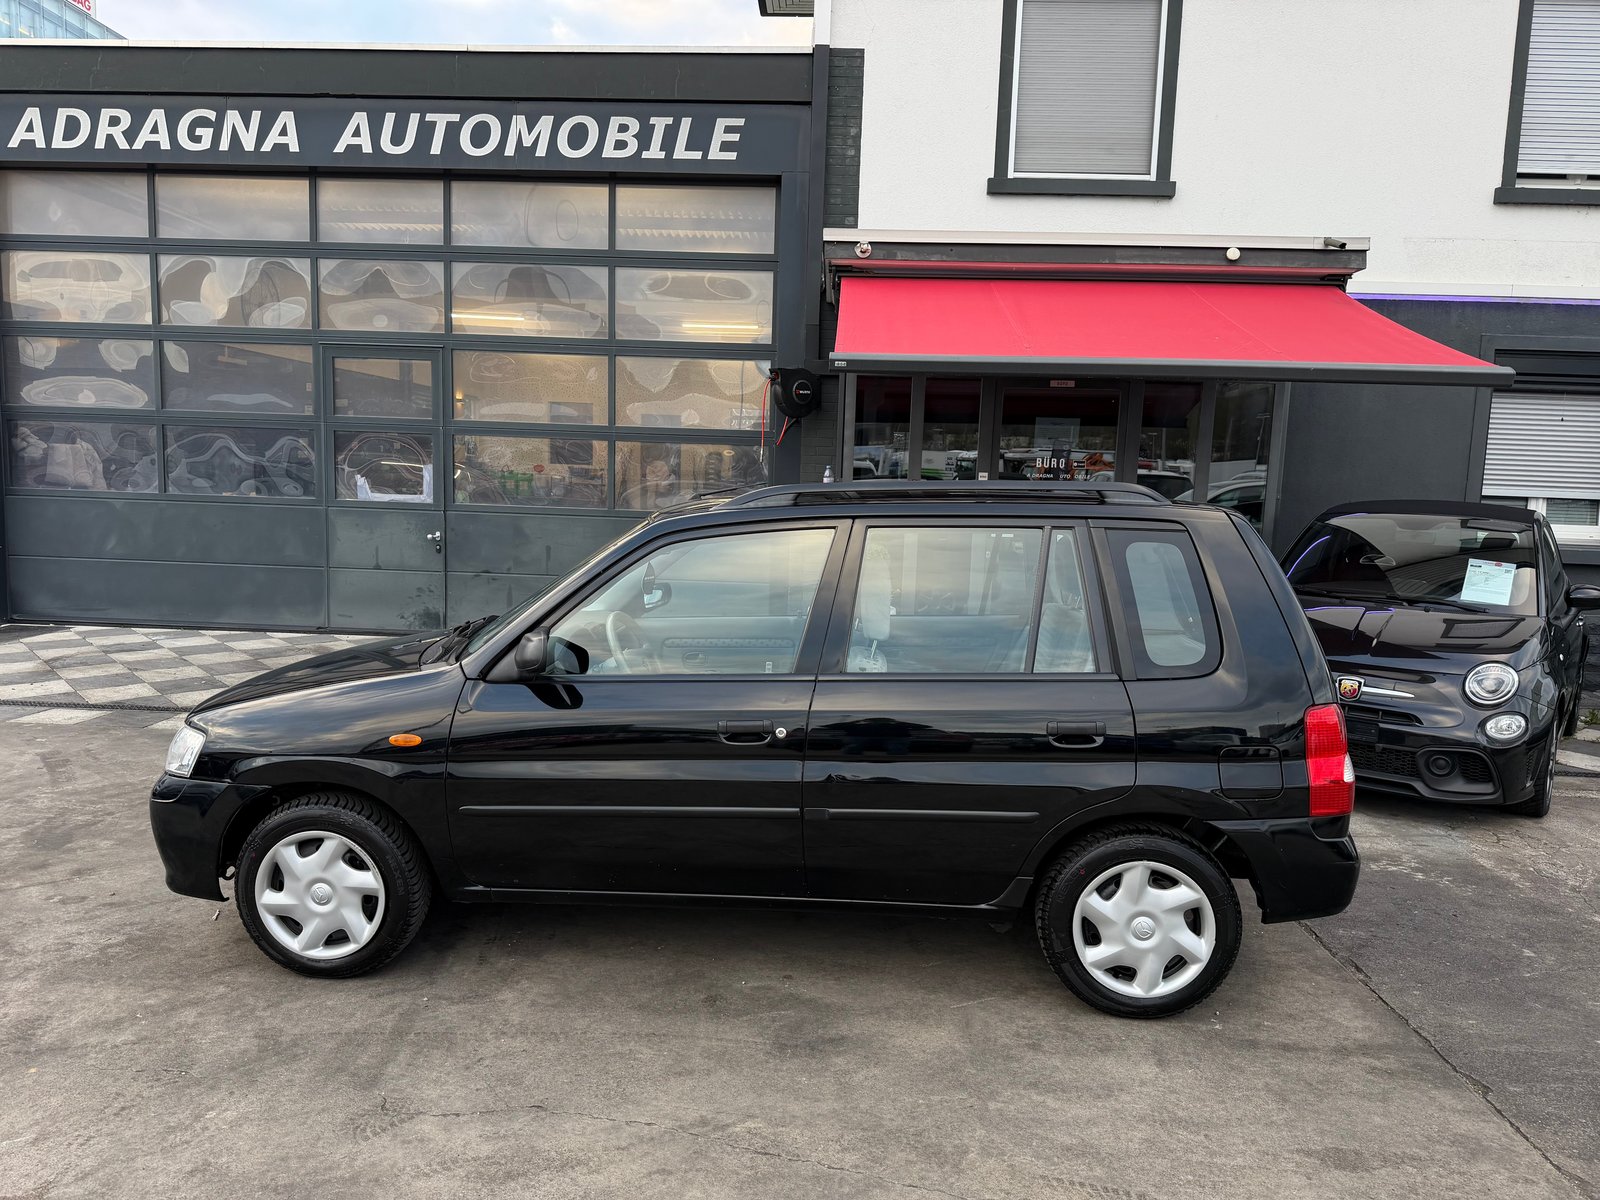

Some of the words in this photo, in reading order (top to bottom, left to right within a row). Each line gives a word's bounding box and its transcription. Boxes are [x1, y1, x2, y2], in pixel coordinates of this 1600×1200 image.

[71, 0, 92, 11] AG
[7, 107, 300, 152] ADRAGNA
[333, 111, 746, 160] AUTOMOBILE
[1035, 456, 1066, 469] BÜRO
